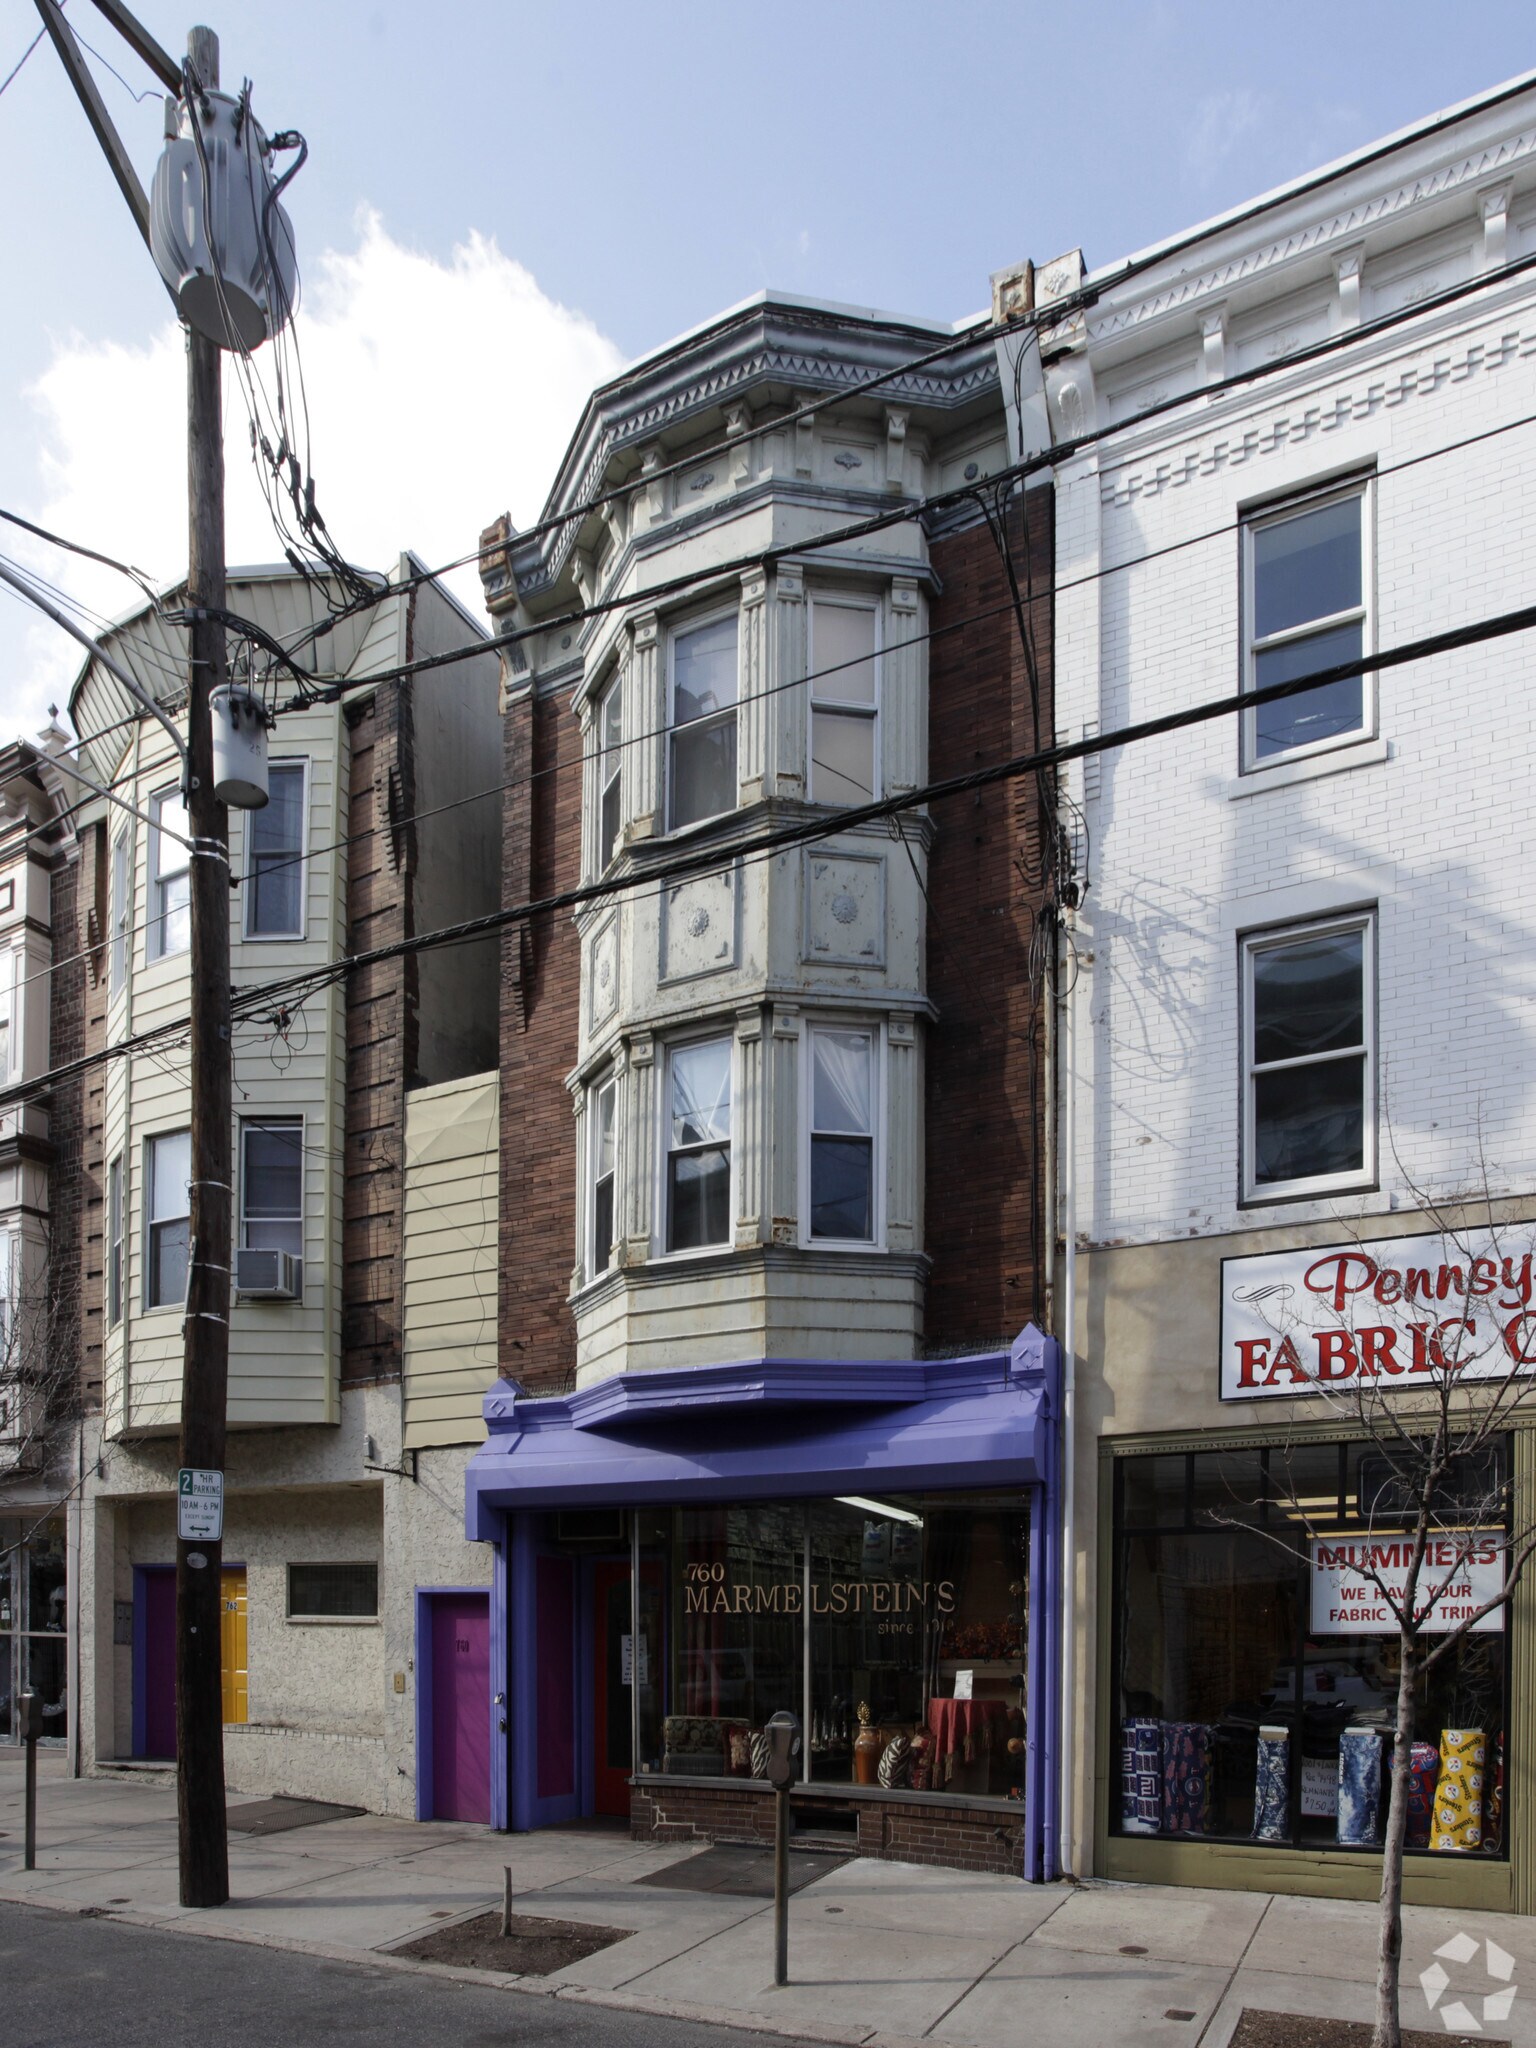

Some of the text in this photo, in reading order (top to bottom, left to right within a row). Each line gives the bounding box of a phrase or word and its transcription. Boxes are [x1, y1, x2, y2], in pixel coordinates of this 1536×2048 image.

[1304, 1252, 1536, 1311] Pennsy
[1235, 1318, 1476, 1389] FABRIC
[182, 1474, 214, 1492] 2 HR
[193, 1484, 220, 1495] PARKING
[210, 1502, 220, 1511] PM
[686, 1562, 725, 1583] 760
[1340, 1584, 1472, 1600] WE HAV YOUR
[1329, 1607, 1387, 1622] FABRIC
[1394, 1606, 1433, 1621] ND
[1456, 1736, 1481, 1755] Steelers
[1458, 1774, 1472, 1801] Steelers
[1438, 1795, 1463, 1813] Steelers
[1449, 1817, 1475, 1833] Steelers
